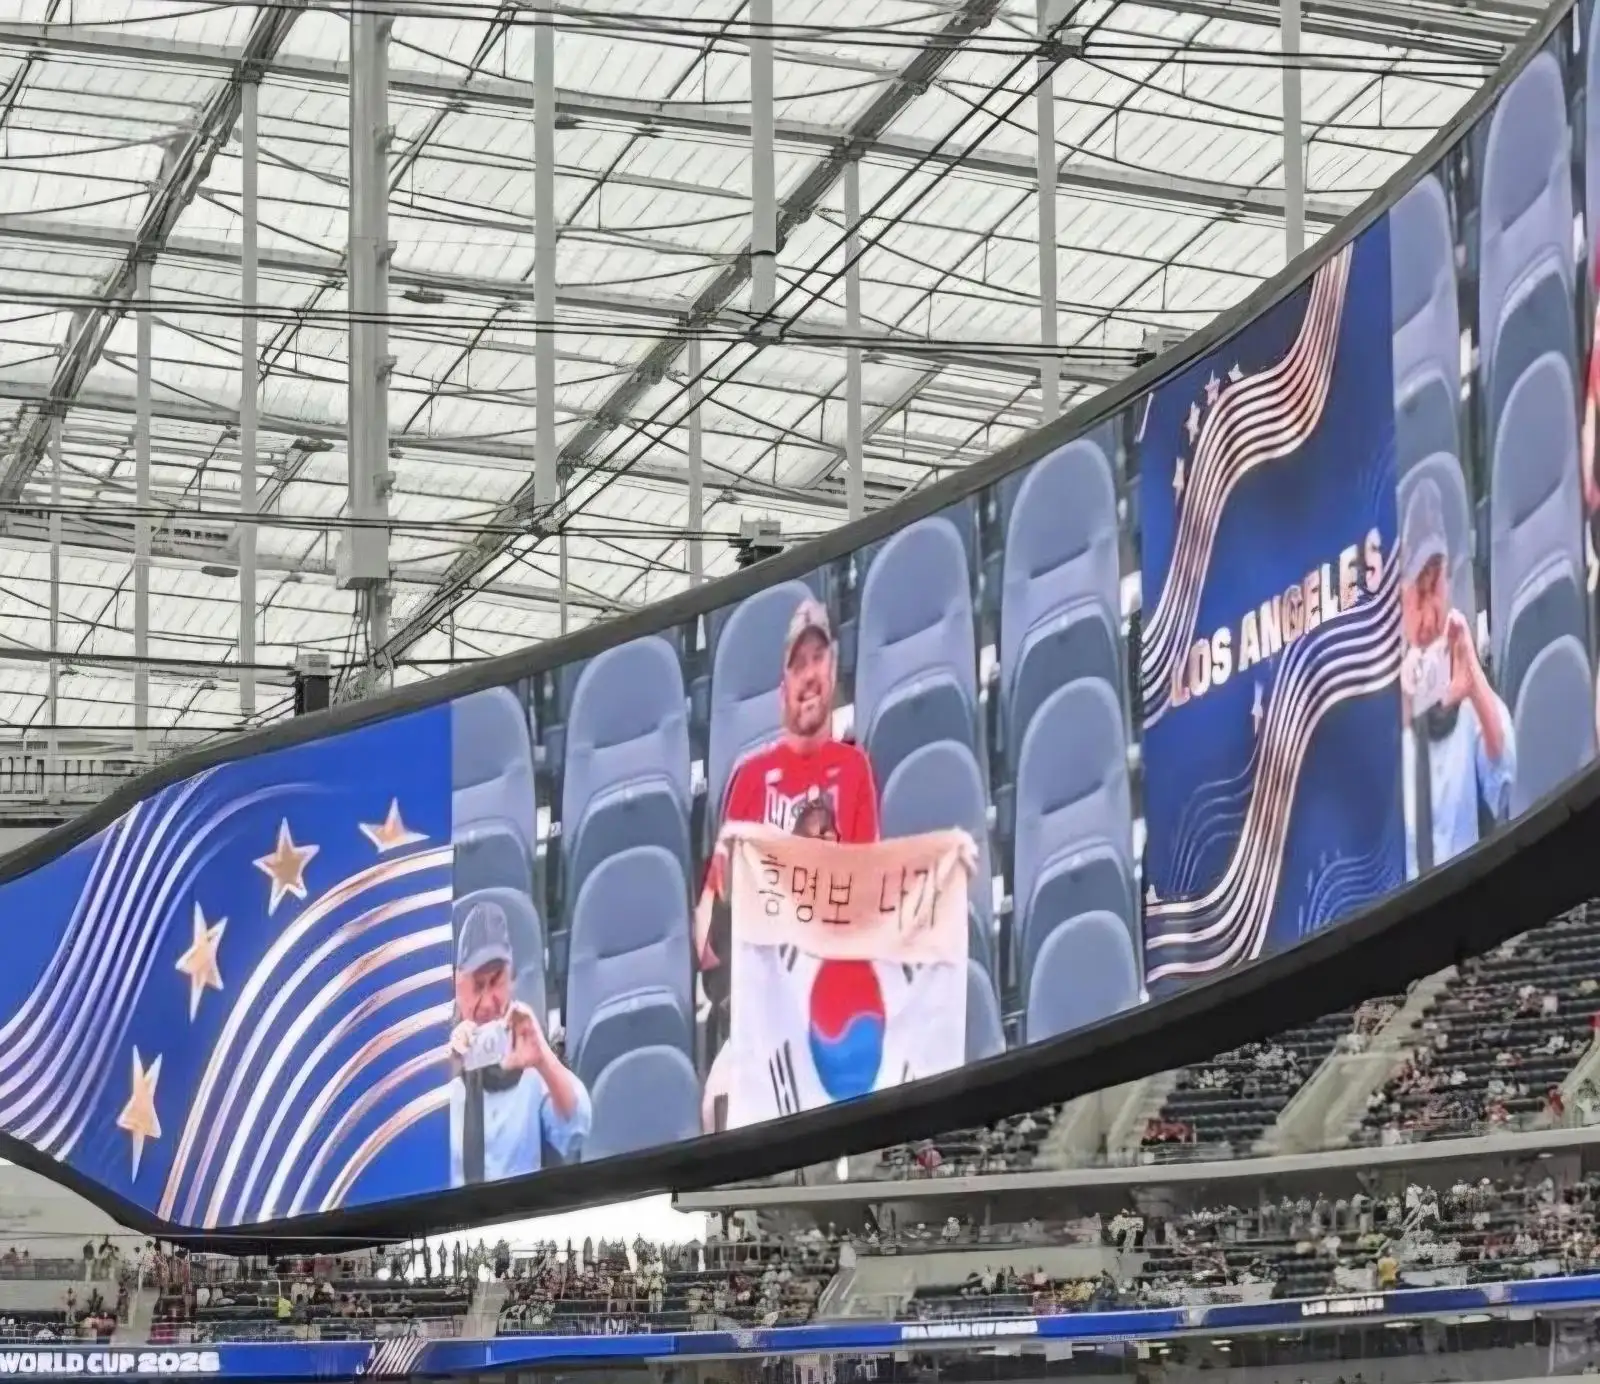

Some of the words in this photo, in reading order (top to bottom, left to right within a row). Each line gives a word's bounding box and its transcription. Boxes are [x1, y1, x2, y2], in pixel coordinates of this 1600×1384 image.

[1171, 626, 1232, 708] LOS
[1238, 526, 1384, 672] ANGELES
[0, 1352, 84, 1373] WORLD
[87, 1353, 135, 1373] CUP
[137, 1351, 220, 1372] 2026
